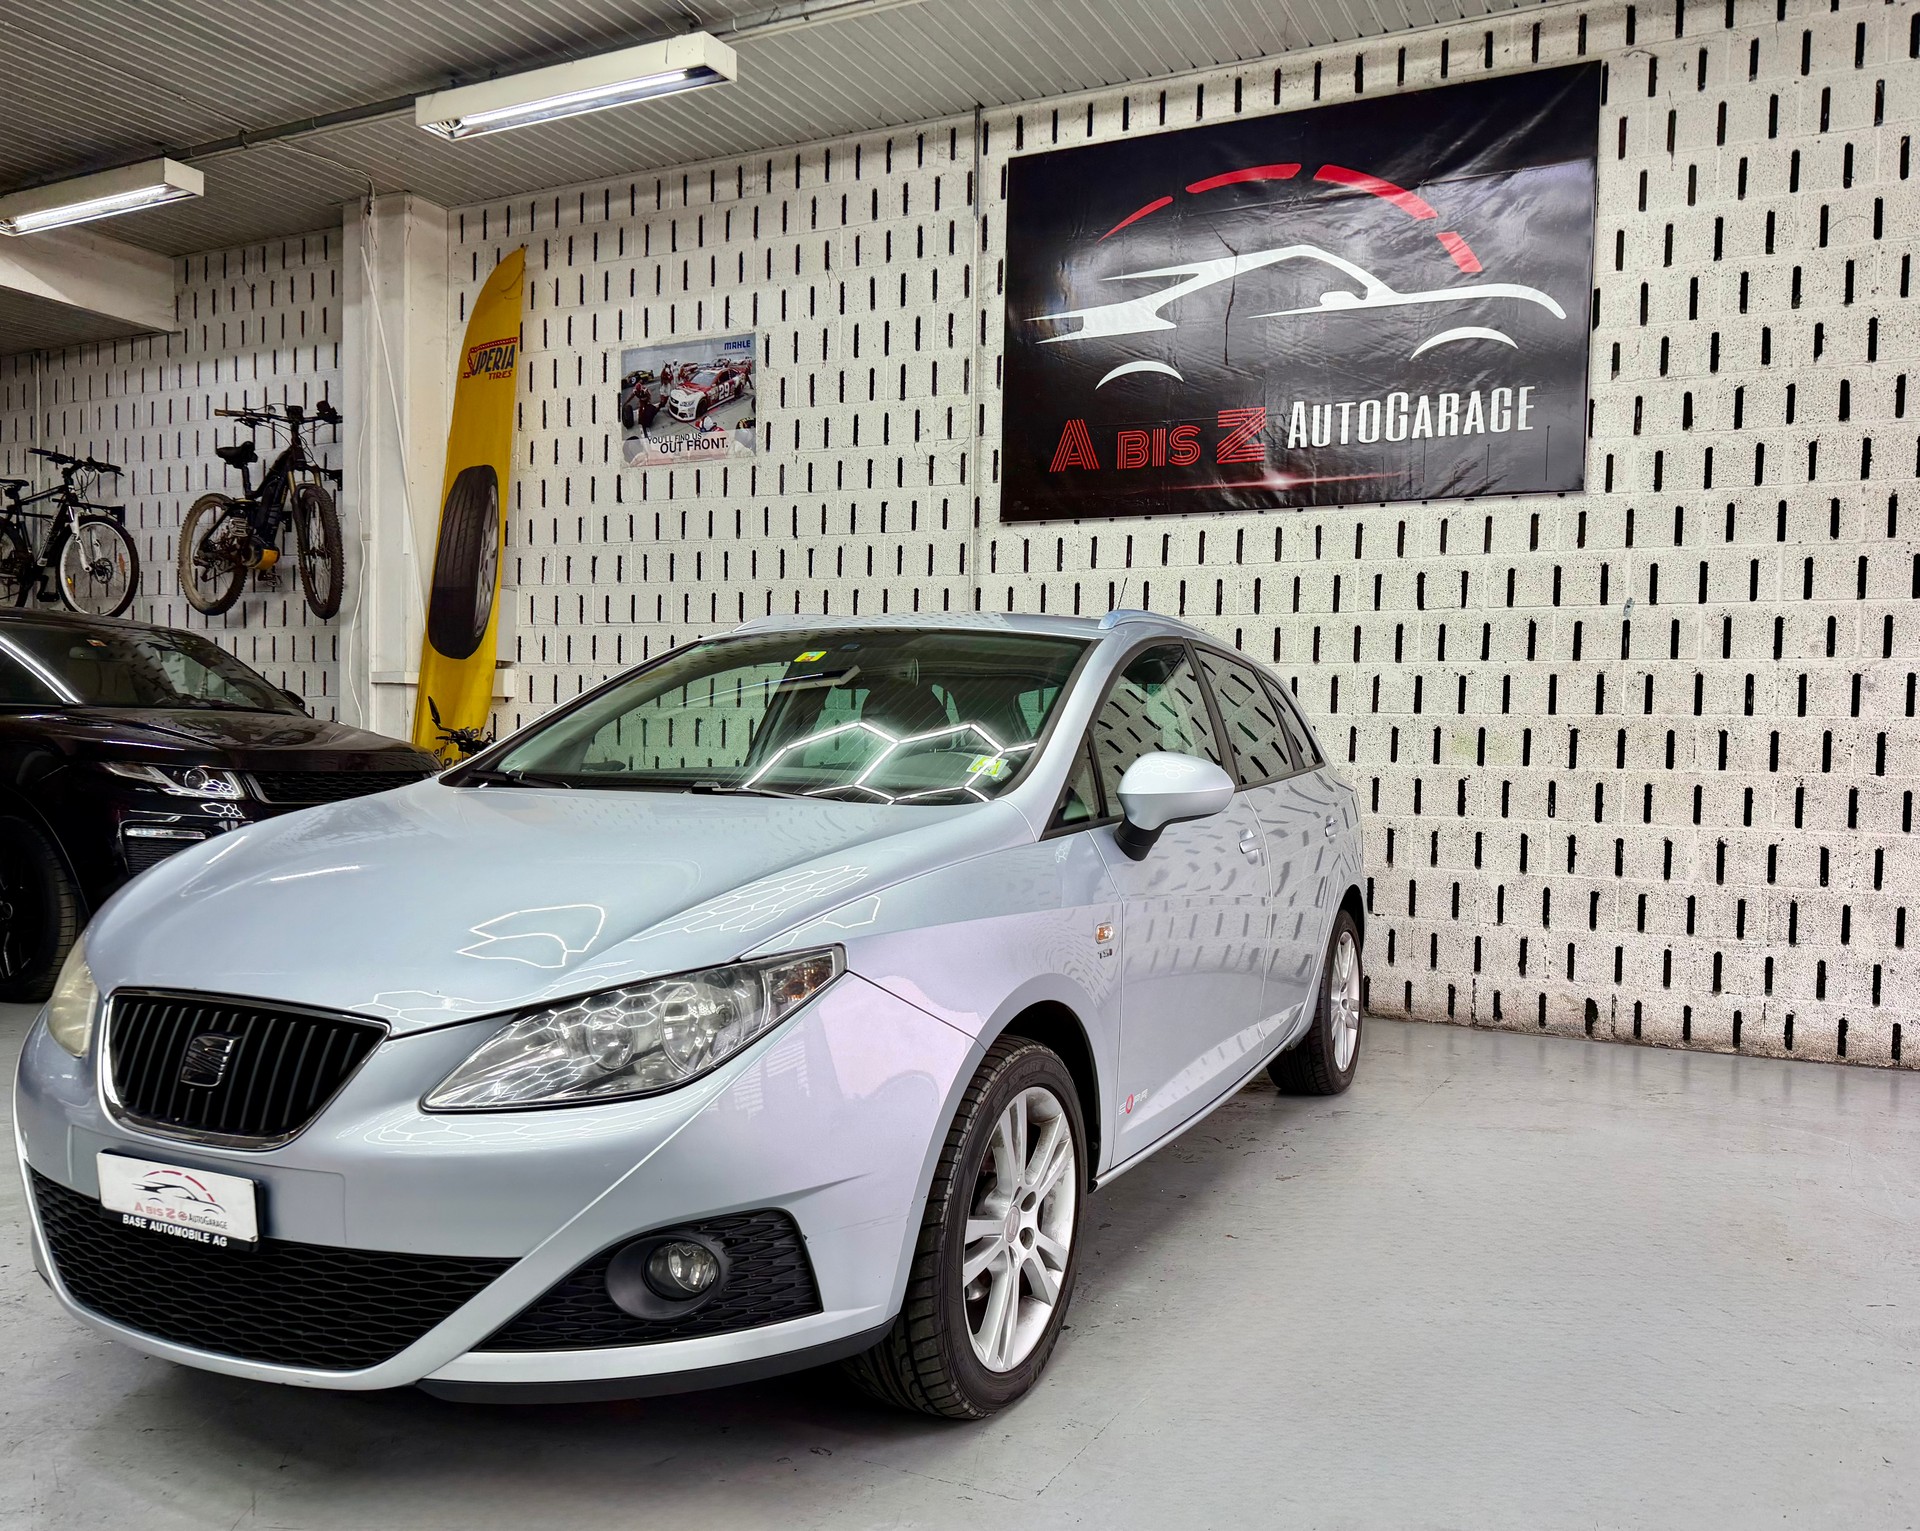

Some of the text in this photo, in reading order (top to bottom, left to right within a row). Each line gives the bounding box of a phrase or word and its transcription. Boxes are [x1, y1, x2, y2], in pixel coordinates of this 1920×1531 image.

[724, 339, 751, 351] MAHLE
[488, 370, 513, 380] TIRES
[718, 382, 730, 401] 29
[675, 433, 690, 443] FIND
[691, 432, 702, 441] US
[1049, 385, 1536, 473] A BIS Z AUTOGARAGE
[660, 437, 729, 454] OUT FRONT.
[1097, 948, 1113, 959] TSI
[134, 1202, 145, 1213] A
[145, 1206, 164, 1218] BIS
[165, 1207, 176, 1220] Z
[122, 1213, 228, 1247] BASE AUTOMOBILE AG
